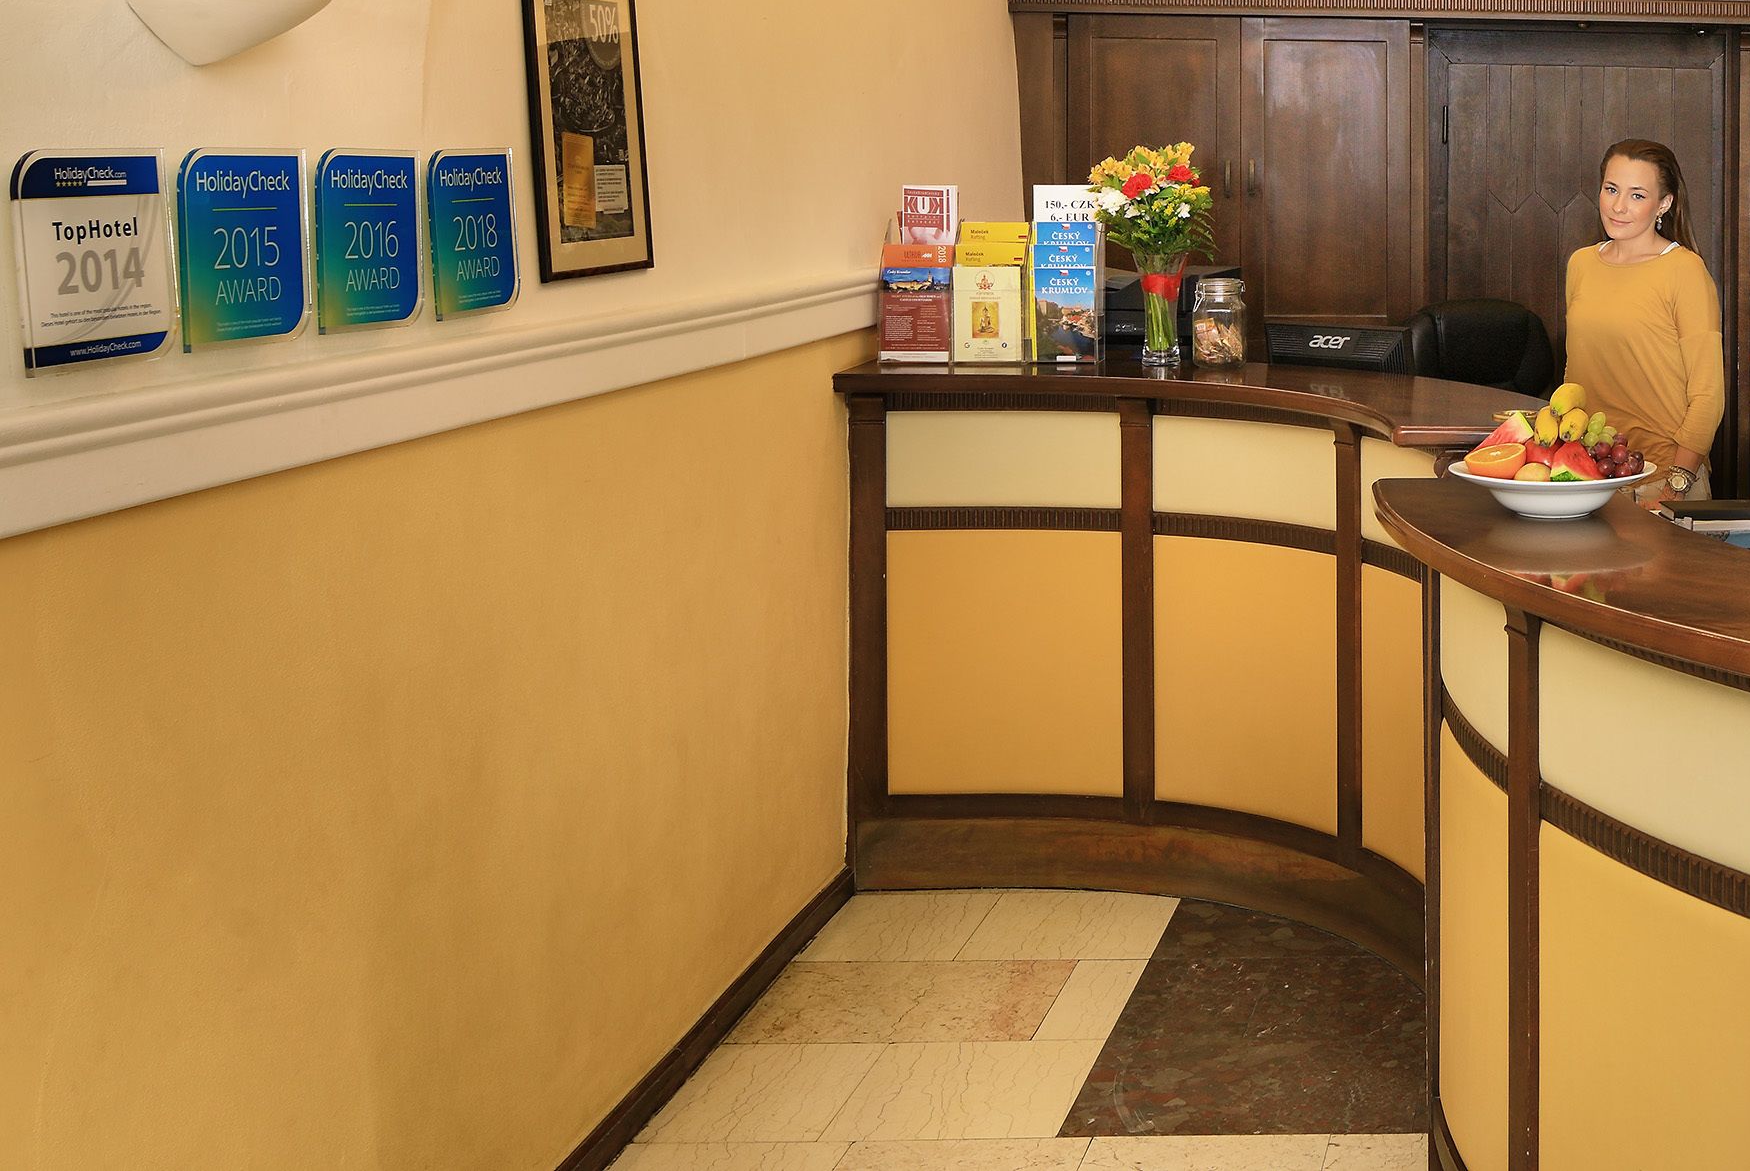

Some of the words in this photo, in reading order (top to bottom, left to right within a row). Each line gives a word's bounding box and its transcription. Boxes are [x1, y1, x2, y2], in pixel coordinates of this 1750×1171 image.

[589, 4, 619, 44] 50%
[53, 166, 127, 183] HolidayCheck.com
[196, 170, 290, 199] HolidayCheck
[331, 169, 408, 195] HolidayCheck
[439, 166, 503, 192] HolidayCheck
[1045, 200, 1068, 209] 150,-
[1070, 200, 1095, 209] CZK
[1050, 213, 1063, 222] 6,-
[1066, 213, 1089, 221] EUR
[52, 216, 138, 245] TopHotel
[344, 220, 399, 259] 2016
[453, 213, 498, 251] 2018
[1051, 231, 1081, 240] ČESKÝ
[213, 226, 280, 270] 2015
[937, 245, 947, 263] 2018
[1048, 253, 1078, 263] ČESKÝ
[56, 247, 144, 295] 2014
[345, 266, 400, 292] AWARD
[457, 255, 500, 281] AWARD
[215, 276, 282, 306] AWARD
[1041, 286, 1088, 295] KRUMLOV
[1049, 277, 1079, 286] ČESKÝ
[69, 340, 142, 357] www.HolidayCheck.com
[1308, 334, 1351, 349] acer
